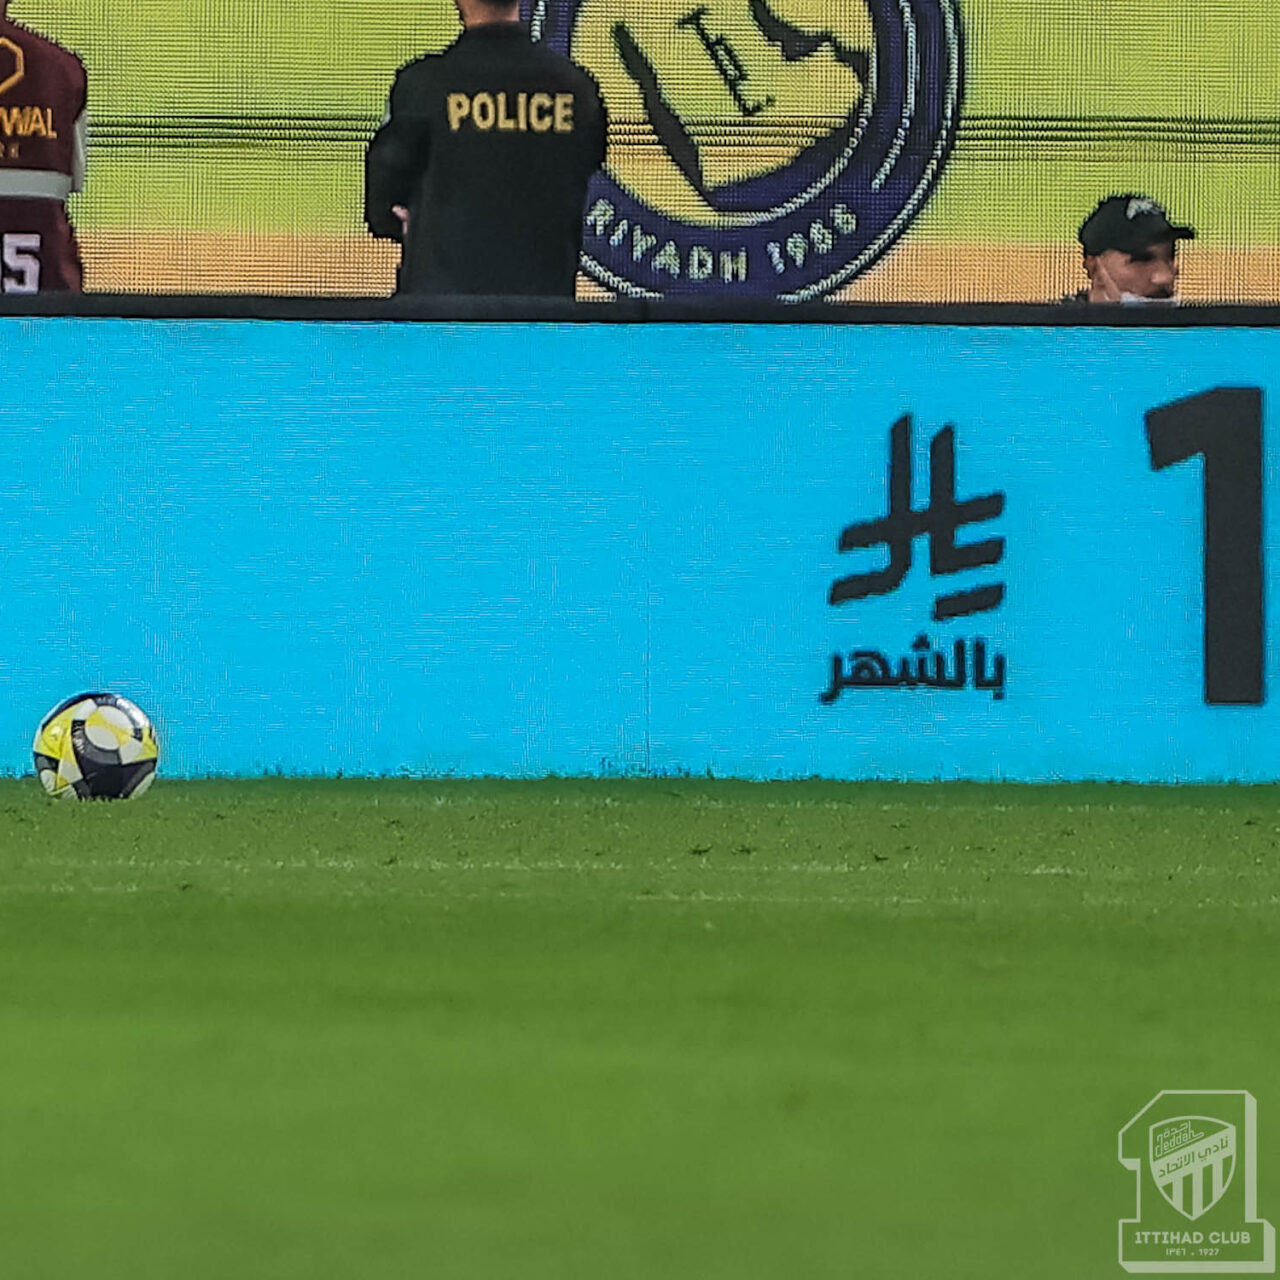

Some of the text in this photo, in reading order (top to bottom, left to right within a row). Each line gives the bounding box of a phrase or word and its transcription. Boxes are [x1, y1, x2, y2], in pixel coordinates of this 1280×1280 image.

[446, 91, 575, 133] POLICE
[1144, 386, 1265, 706] 1
[820, 632, 1006, 704] بالشهر
